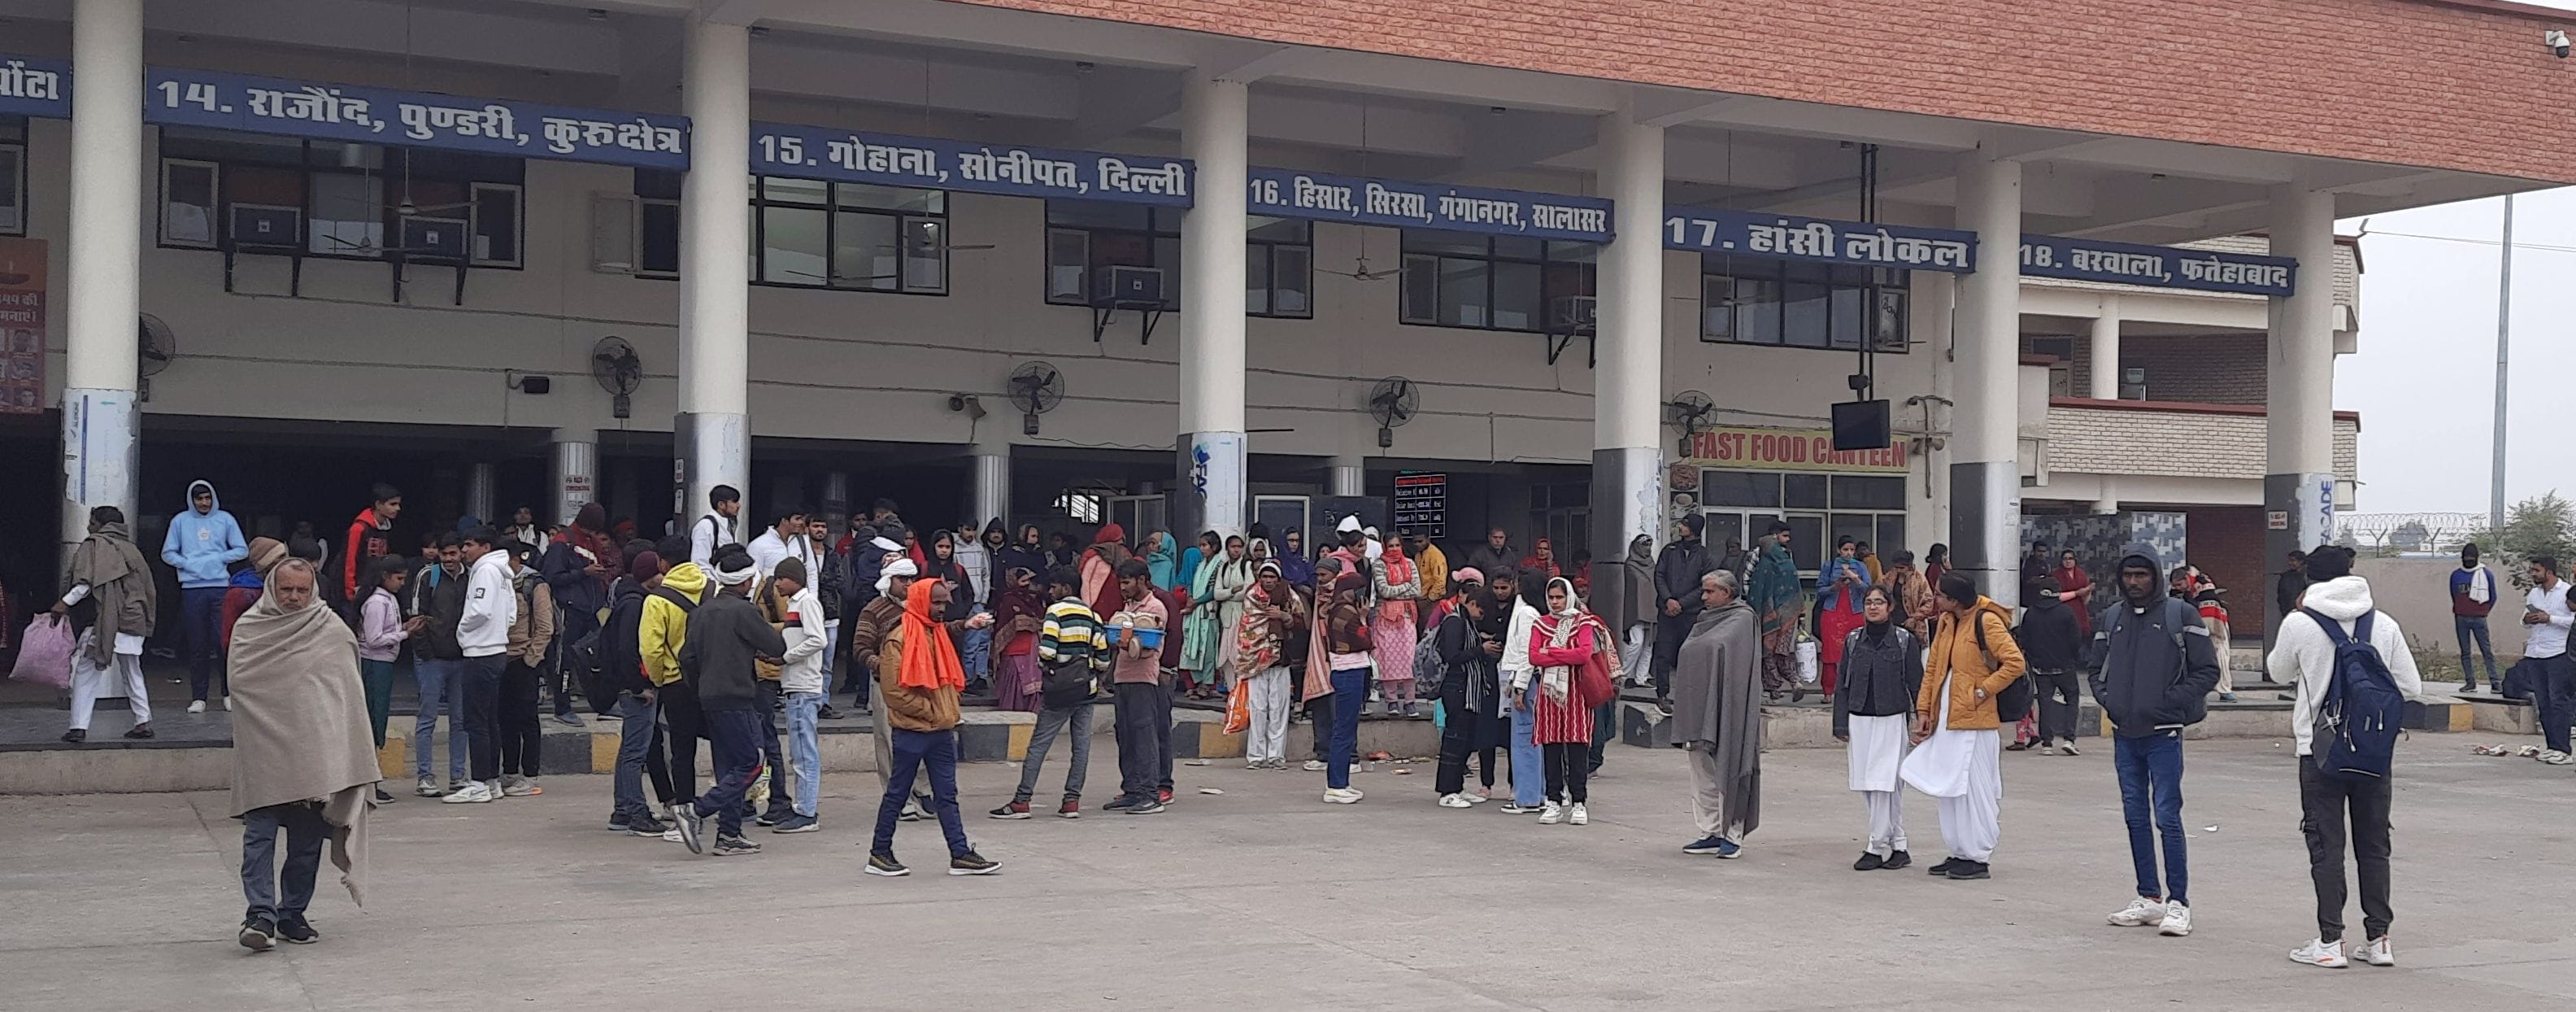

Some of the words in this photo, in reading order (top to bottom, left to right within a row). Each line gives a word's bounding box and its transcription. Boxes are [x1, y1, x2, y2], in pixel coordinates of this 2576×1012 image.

[156, 80, 233, 113] 14.
[398, 103, 529, 146] पुण्डरी,
[542, 117, 682, 154] कुरुक्षेत्र
[758, 134, 817, 167] 15.
[827, 136, 950, 183] गोहाना,
[958, 148, 1090, 194] सोनीपत,
[1098, 157, 1187, 196] दिल्ली
[1250, 178, 1289, 206] 16.
[1294, 175, 1360, 217] हिसार,
[1365, 182, 1434, 224] सिरसा,
[1438, 190, 1527, 231] गंगानगर,
[1532, 203, 1607, 233] सालासर
[1664, 217, 1735, 250] 17.
[1747, 220, 1836, 257] हांसी
[1843, 229, 1969, 268] लोकल
[2020, 244, 2064, 268] 18.
[2070, 248, 2173, 284] बरवाला,
[2180, 255, 2289, 288] फतेहाबाद
[1692, 431, 1746, 460] FAST
[1751, 434, 1807, 463] FOOD
